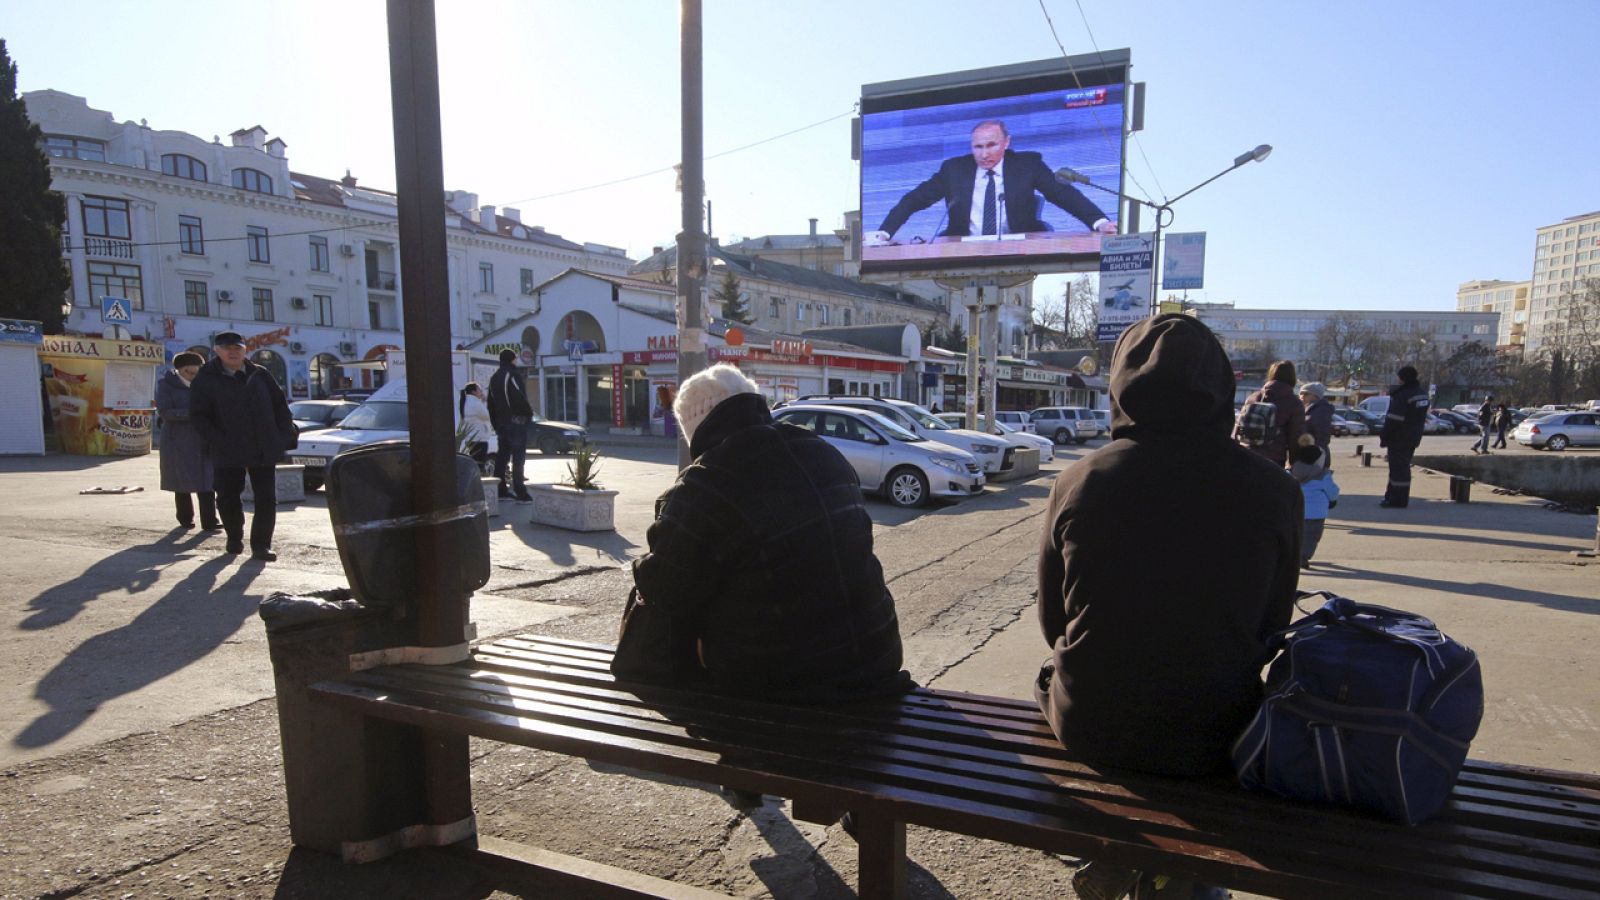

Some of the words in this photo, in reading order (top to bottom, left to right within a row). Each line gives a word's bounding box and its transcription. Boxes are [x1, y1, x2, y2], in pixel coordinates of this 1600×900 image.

[1103, 255, 1125, 263] АВИА
[1132, 251, 1150, 262] Ж/Д
[1109, 261, 1142, 270] БИЛЕТЫ
[118, 344, 162, 358] КВАС
